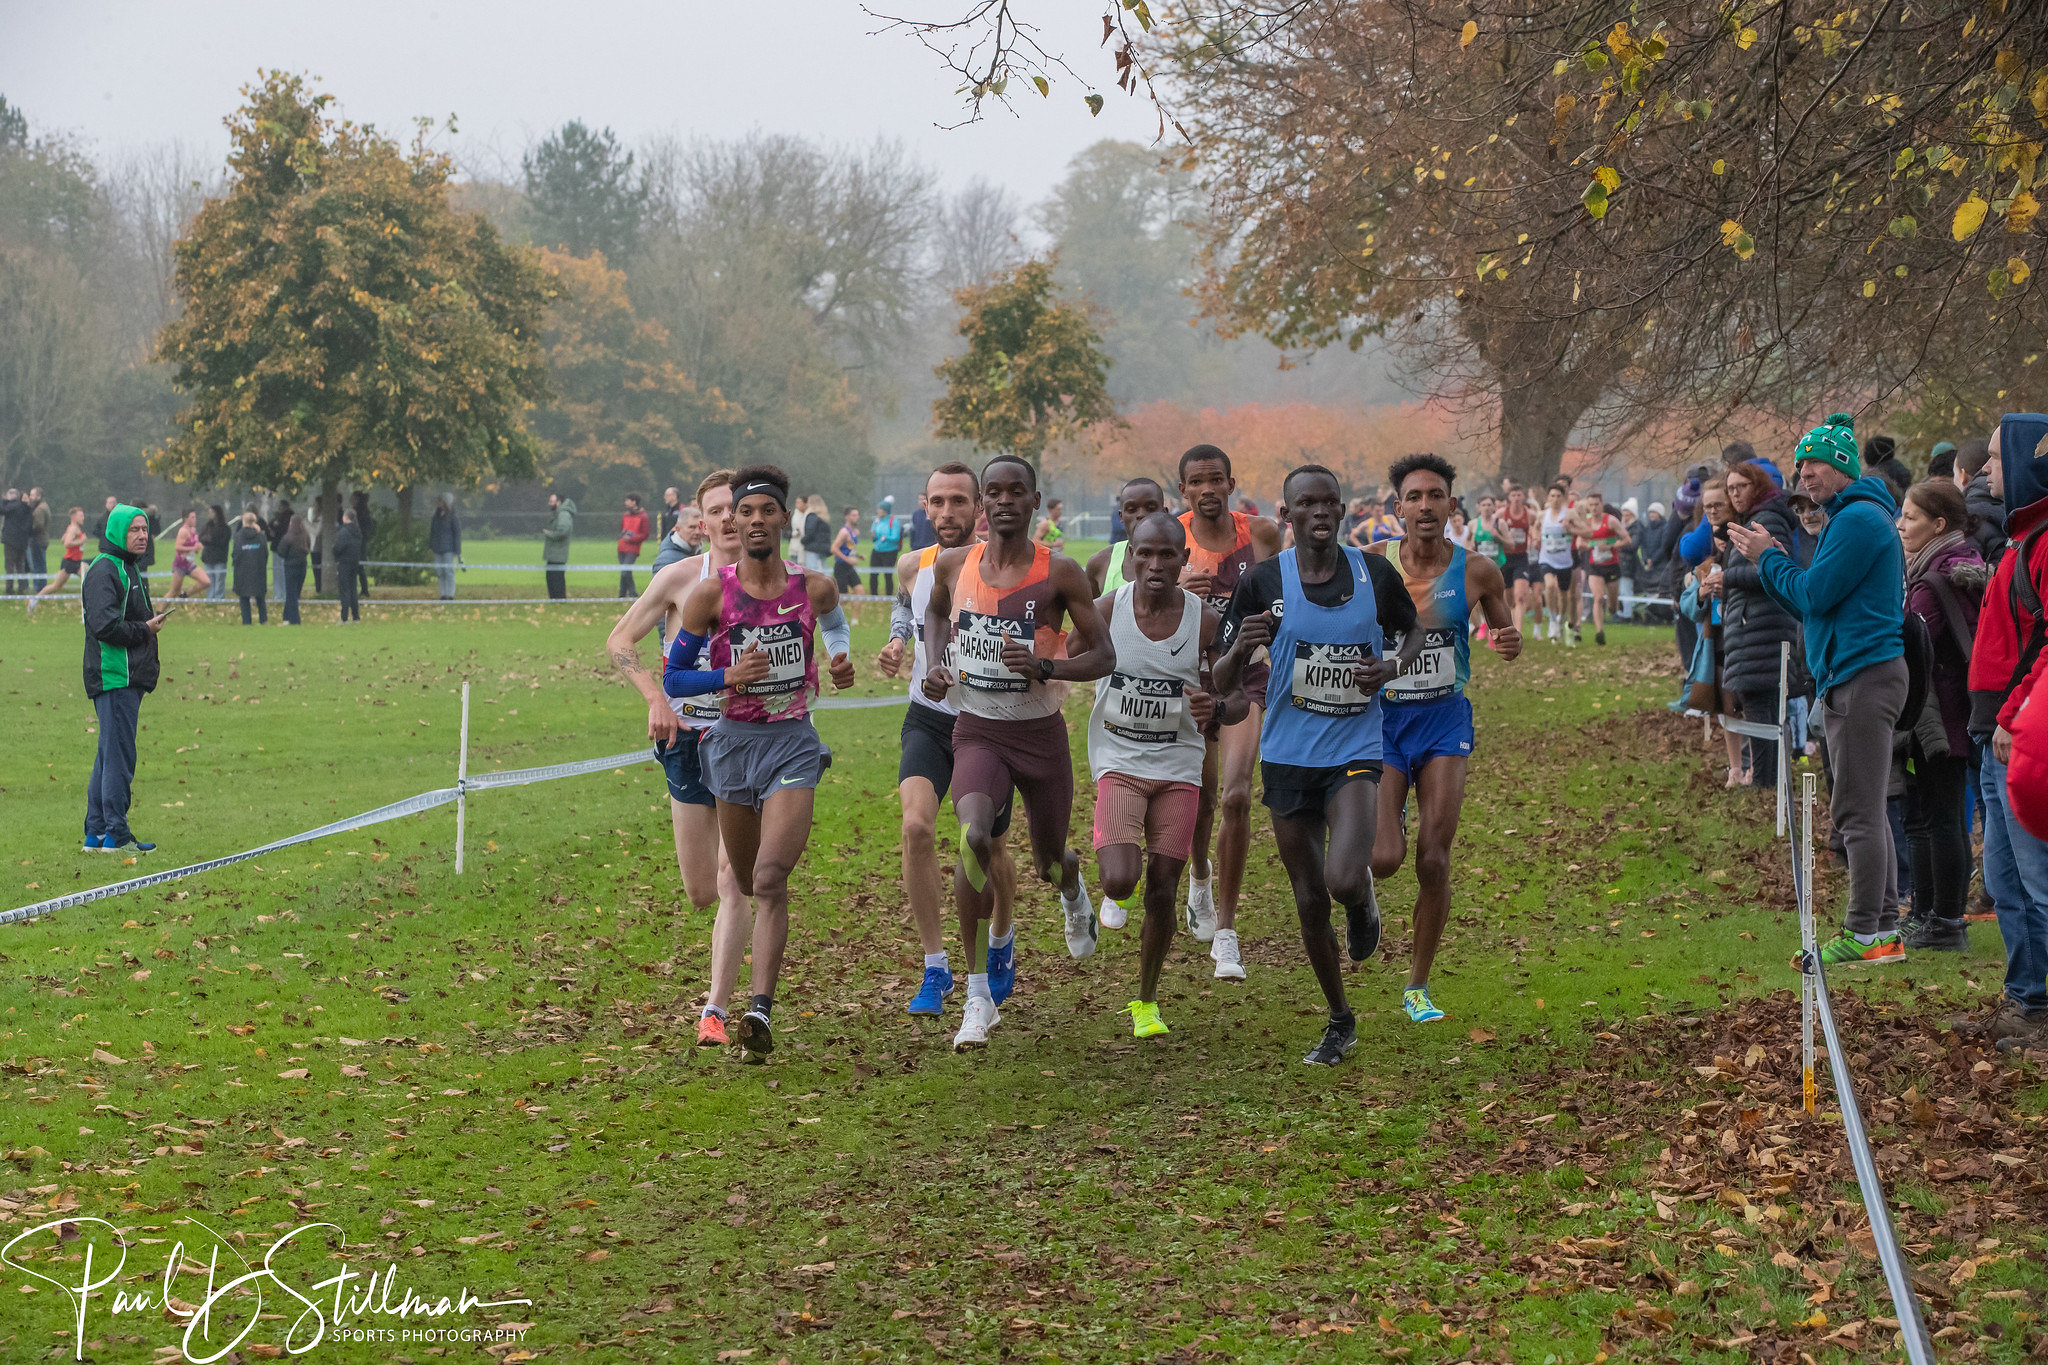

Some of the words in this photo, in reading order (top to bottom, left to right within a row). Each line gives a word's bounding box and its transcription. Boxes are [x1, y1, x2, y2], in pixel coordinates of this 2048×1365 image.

[1433, 589, 1456, 600] HOKA
[760, 624, 792, 637] UKA
[987, 617, 1022, 631] UKA
[1425, 632, 1444, 642] KA
[733, 642, 802, 667] MAMED
[1329, 645, 1361, 656] UKA
[1404, 652, 1441, 676] IDEY
[1140, 680, 1172, 691] UKA
[1120, 695, 1167, 719] MUTAI
